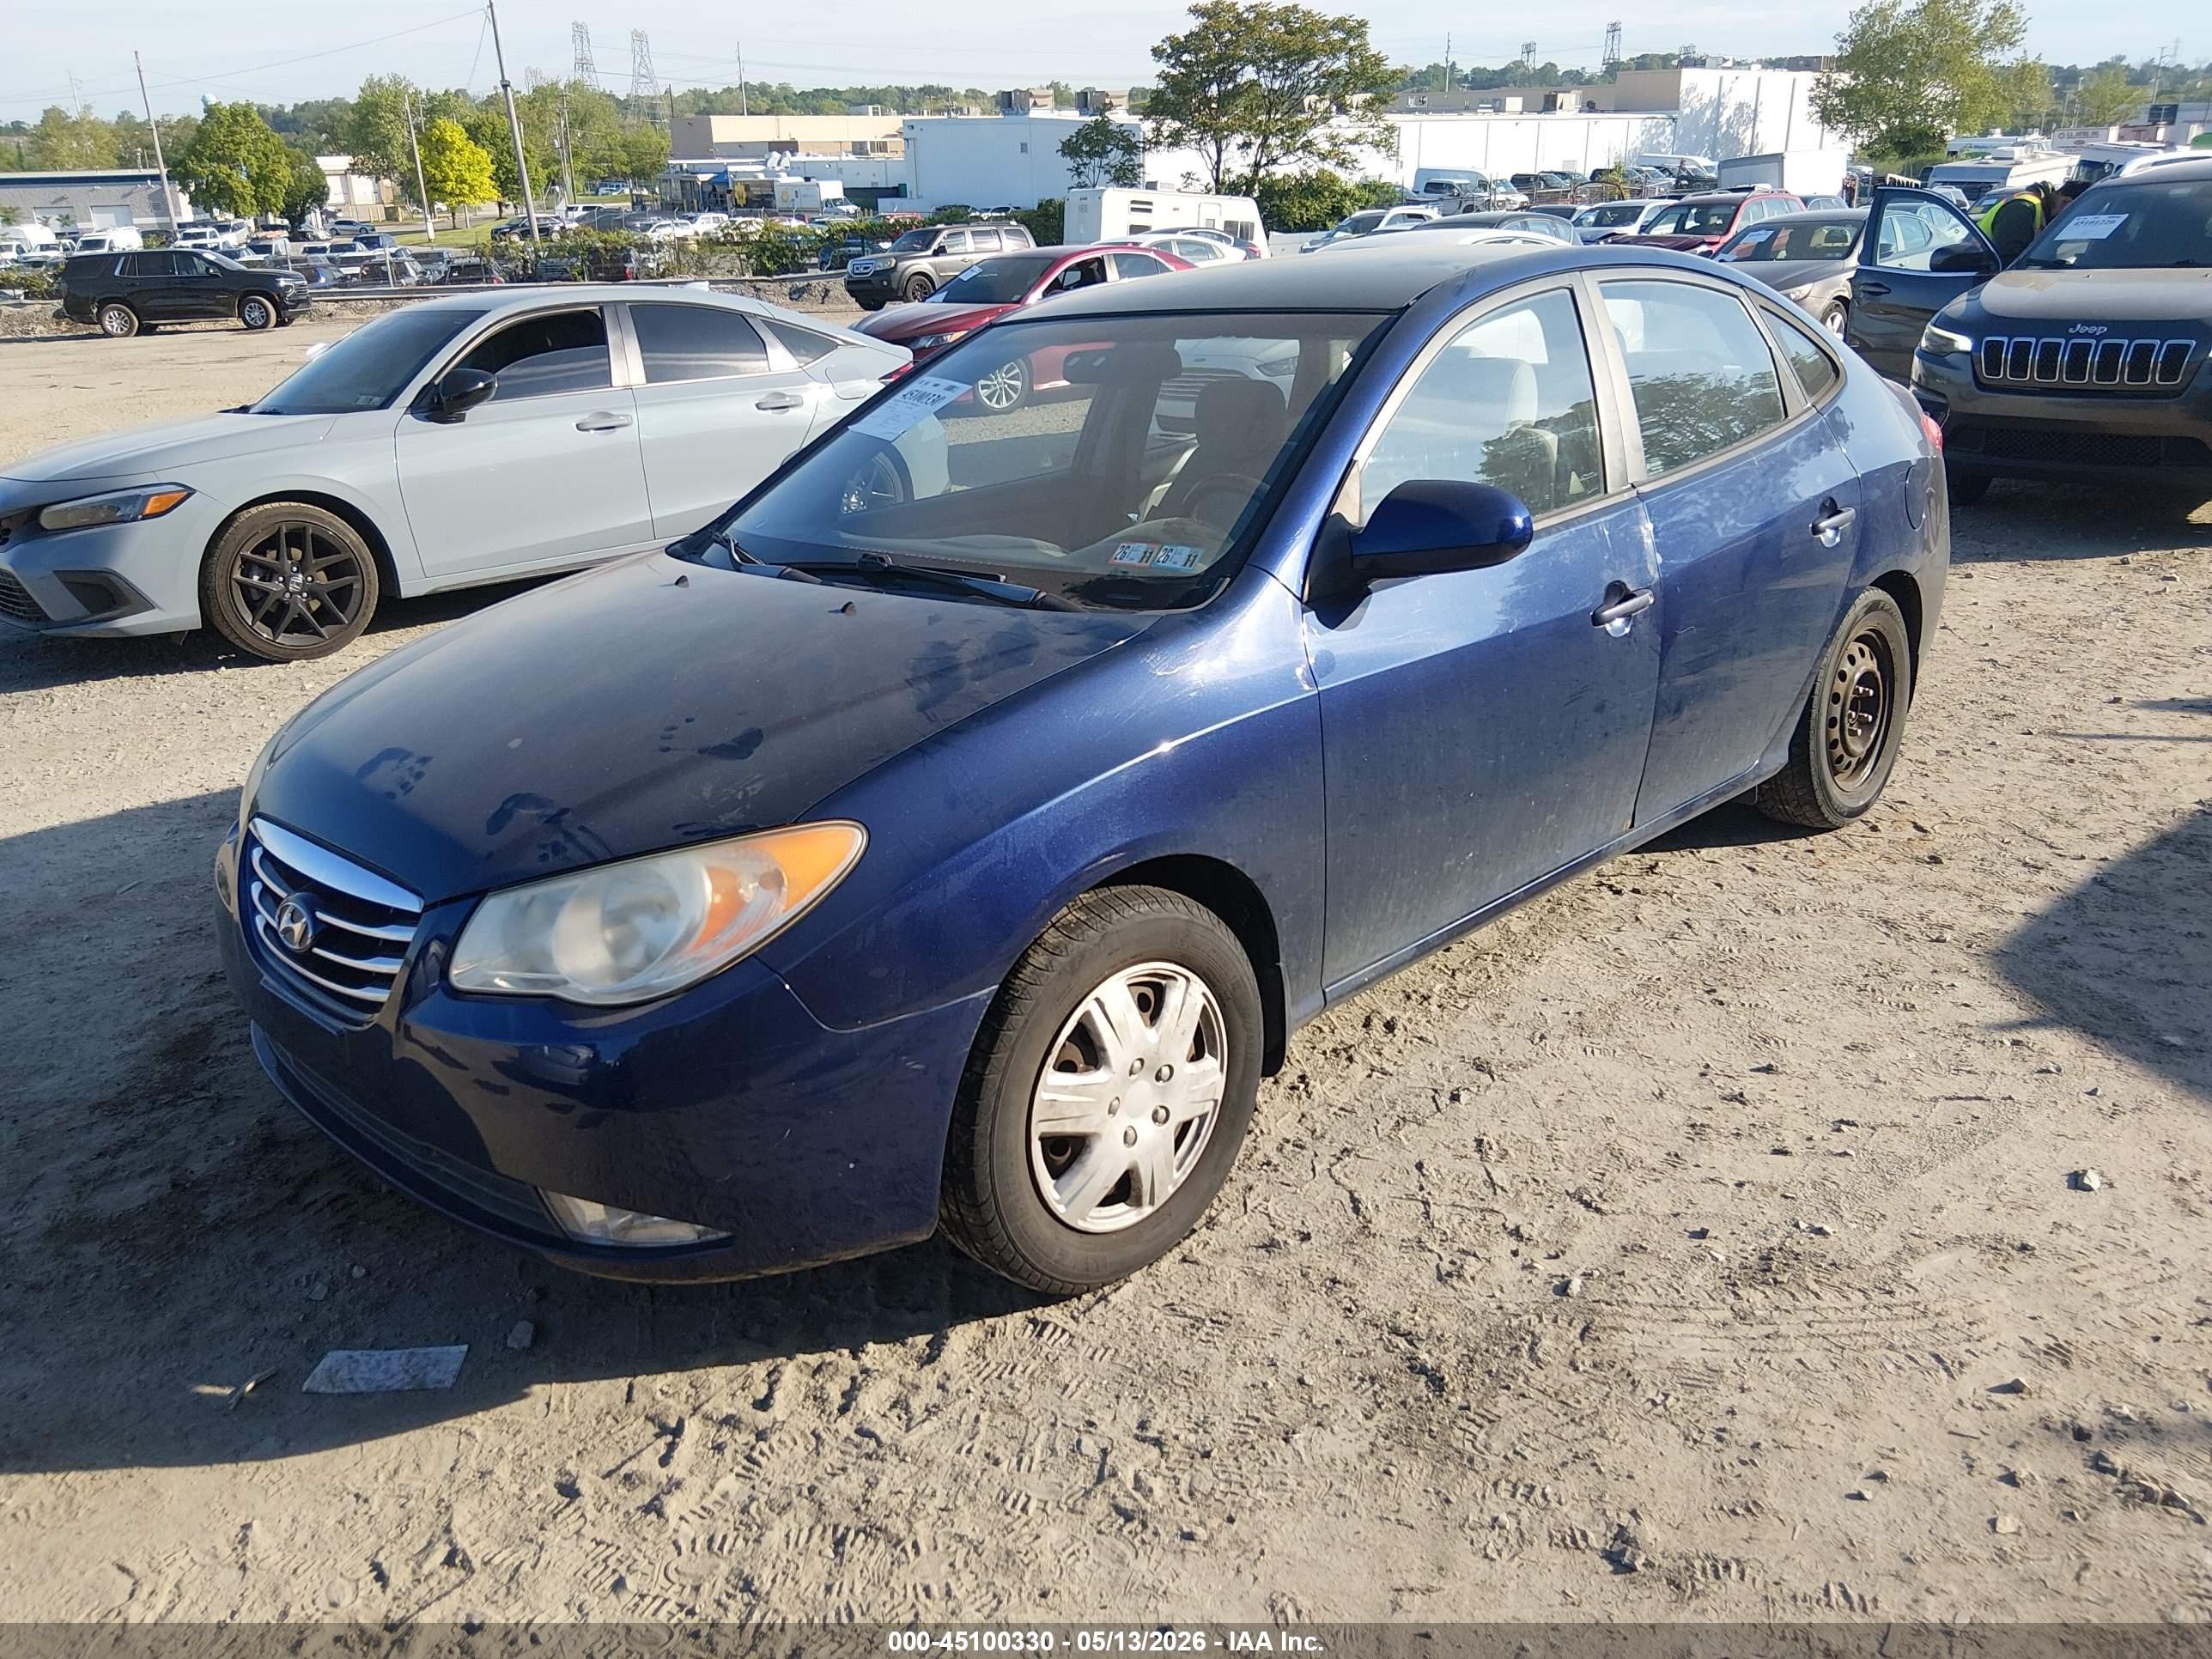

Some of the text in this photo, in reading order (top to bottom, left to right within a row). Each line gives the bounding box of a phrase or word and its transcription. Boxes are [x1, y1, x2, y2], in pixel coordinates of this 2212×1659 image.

[2068, 324, 2108, 336] Jeep
[1114, 544, 1154, 563] 26 11
[1157, 548, 1199, 568] 26 11
